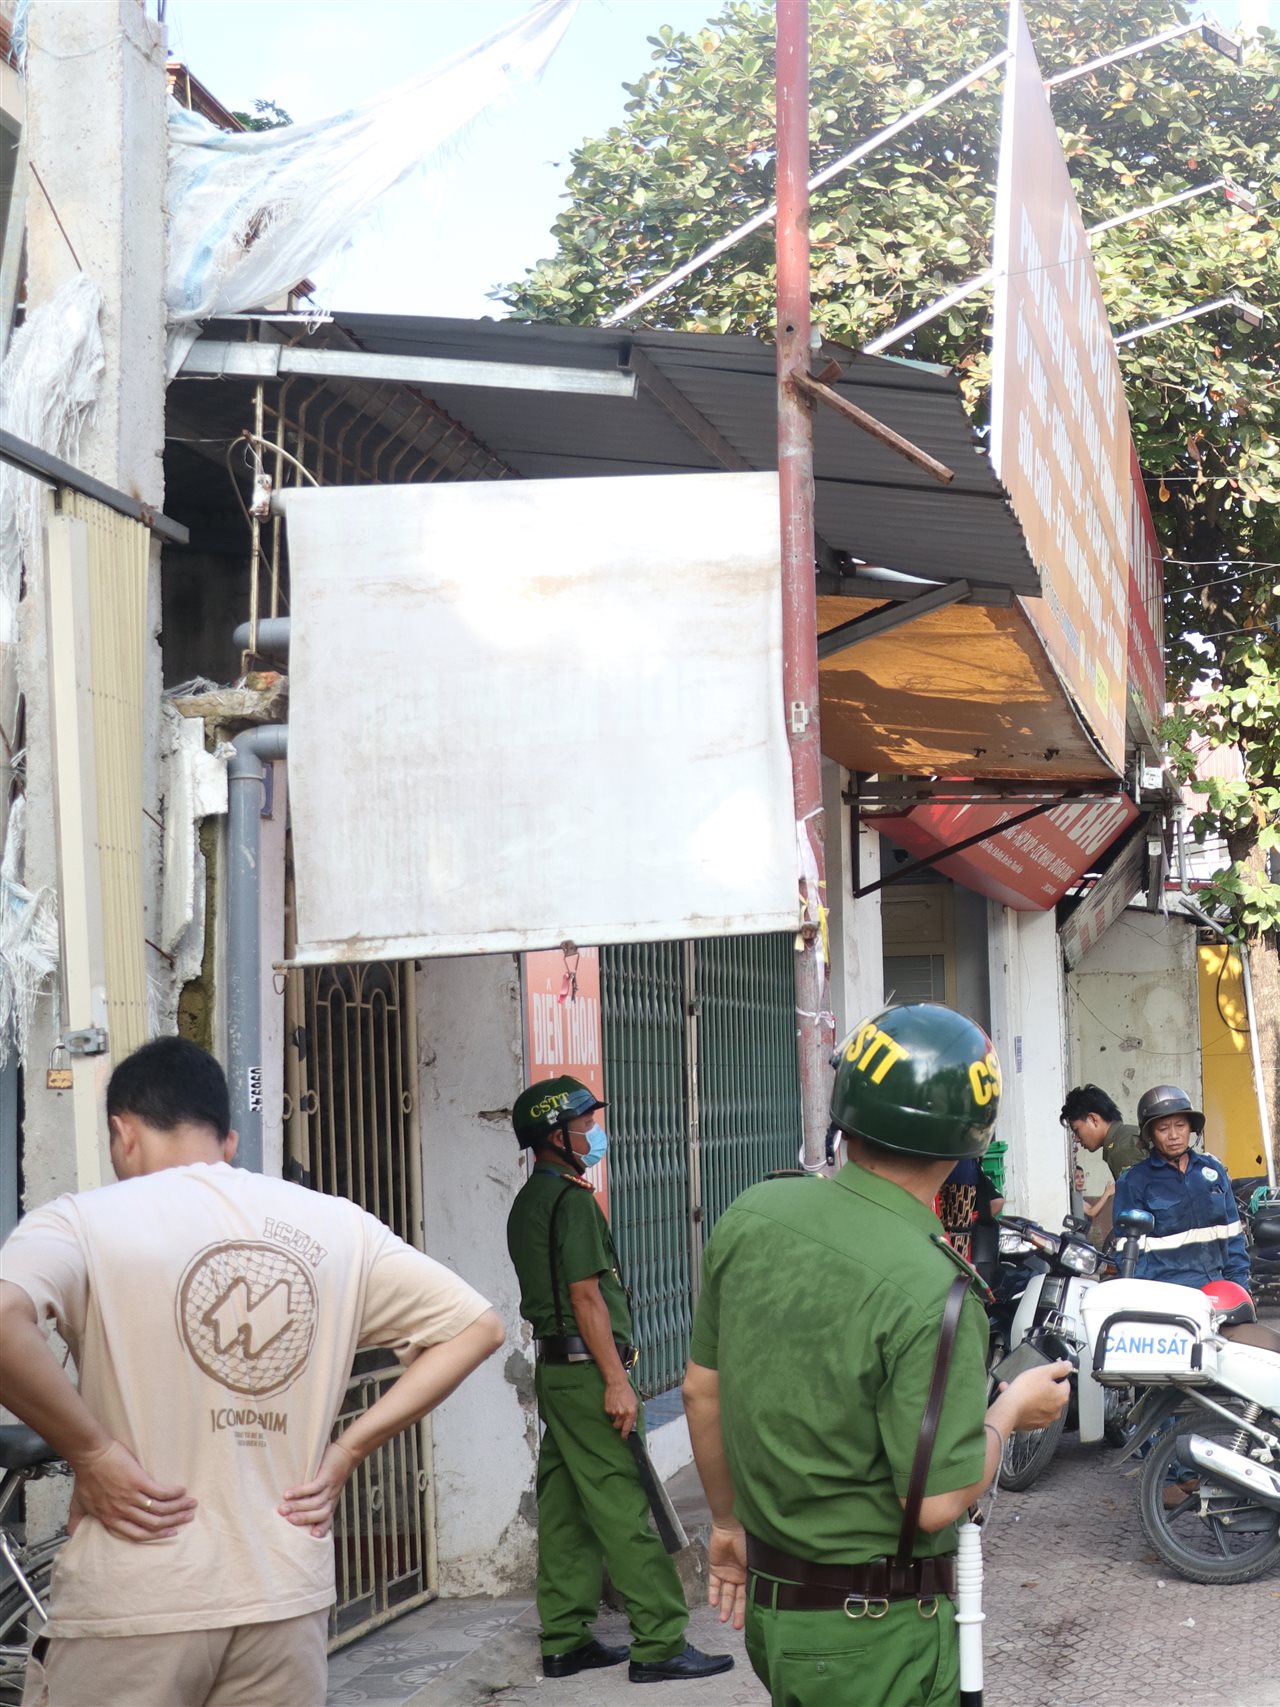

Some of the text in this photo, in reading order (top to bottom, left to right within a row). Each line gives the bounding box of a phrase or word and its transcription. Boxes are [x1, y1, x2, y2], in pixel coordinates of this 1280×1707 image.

[1017, 294, 1028, 374] ỐP
[1029, 339, 1047, 426] LƯNG
[1020, 203, 1041, 316] PHỤ
[1042, 269, 1064, 374] KIỆN
[1064, 333, 1081, 425] ĐIỆN
[1059, 198, 1117, 440] AT MOBILE
[1018, 404, 1033, 490] SỬA
[1035, 447, 1052, 529] CHỮA
[565, 998, 600, 1081] THOẠI
[844, 1020, 911, 1086] STT
[530, 1091, 570, 1118] CSTT
[1157, 1332, 1188, 1355] SÁT
